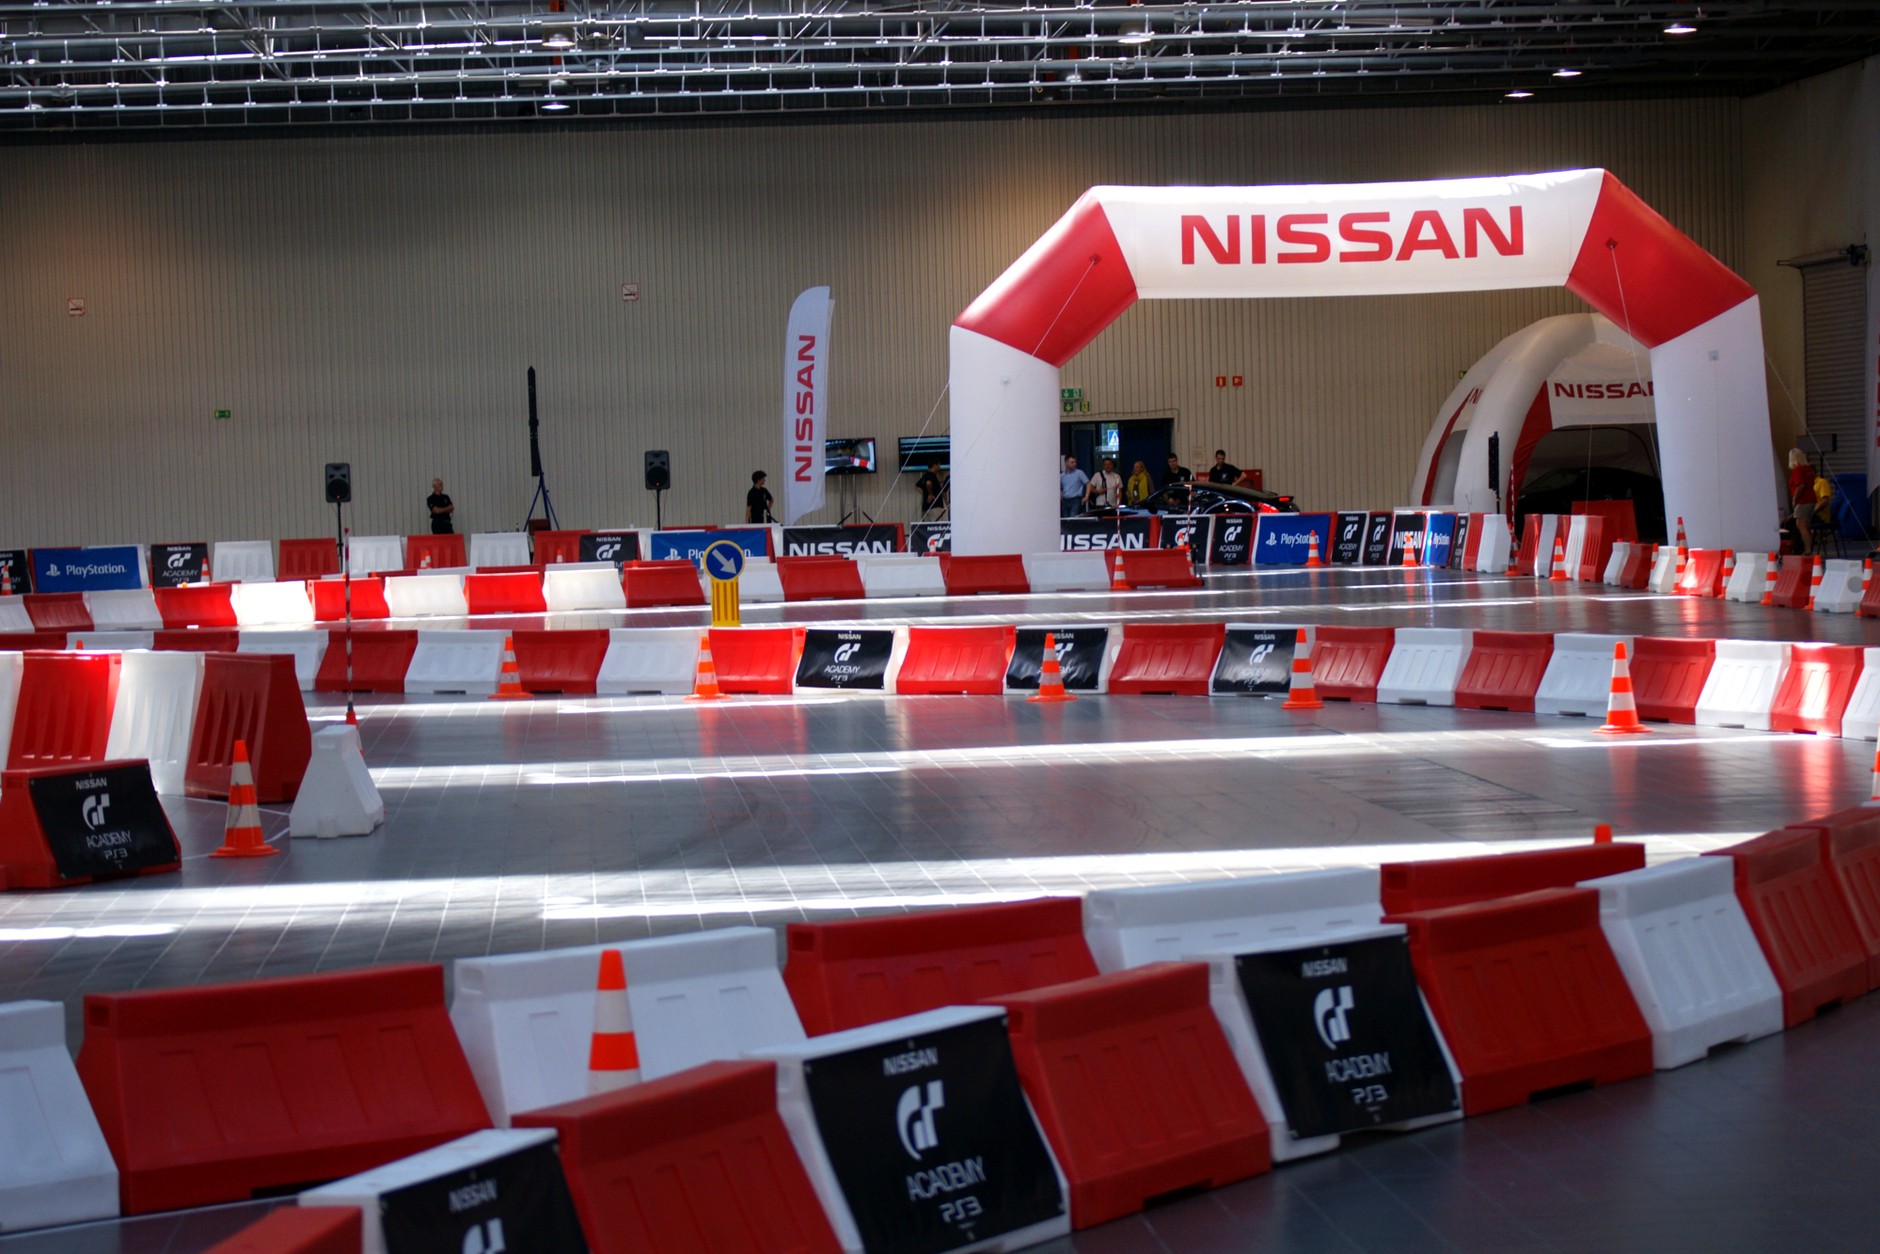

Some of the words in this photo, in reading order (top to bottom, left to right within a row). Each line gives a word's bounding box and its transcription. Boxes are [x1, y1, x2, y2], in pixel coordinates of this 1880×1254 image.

[1181, 206, 1524, 265] NISSAN
[795, 335, 816, 482] NISSAN
[789, 540, 891, 557] NISSAN
[1060, 533, 1144, 550] ISSAN
[1280, 532, 1320, 548] PlayStatin
[66, 563, 124, 578] PlayStation
[824, 665, 860, 674] ACADEMY
[76, 777, 108, 790] NISSAN
[86, 830, 132, 848] ACADEMY
[104, 848, 128, 859] PS3
[1302, 957, 1348, 978] NISSAN
[882, 1048, 938, 1076] NISSAN
[1324, 1051, 1392, 1082] ACADEMY
[1352, 1084, 1388, 1104] PS3
[906, 1155, 987, 1201] ACADEMY
[938, 1196, 983, 1223] PS3
